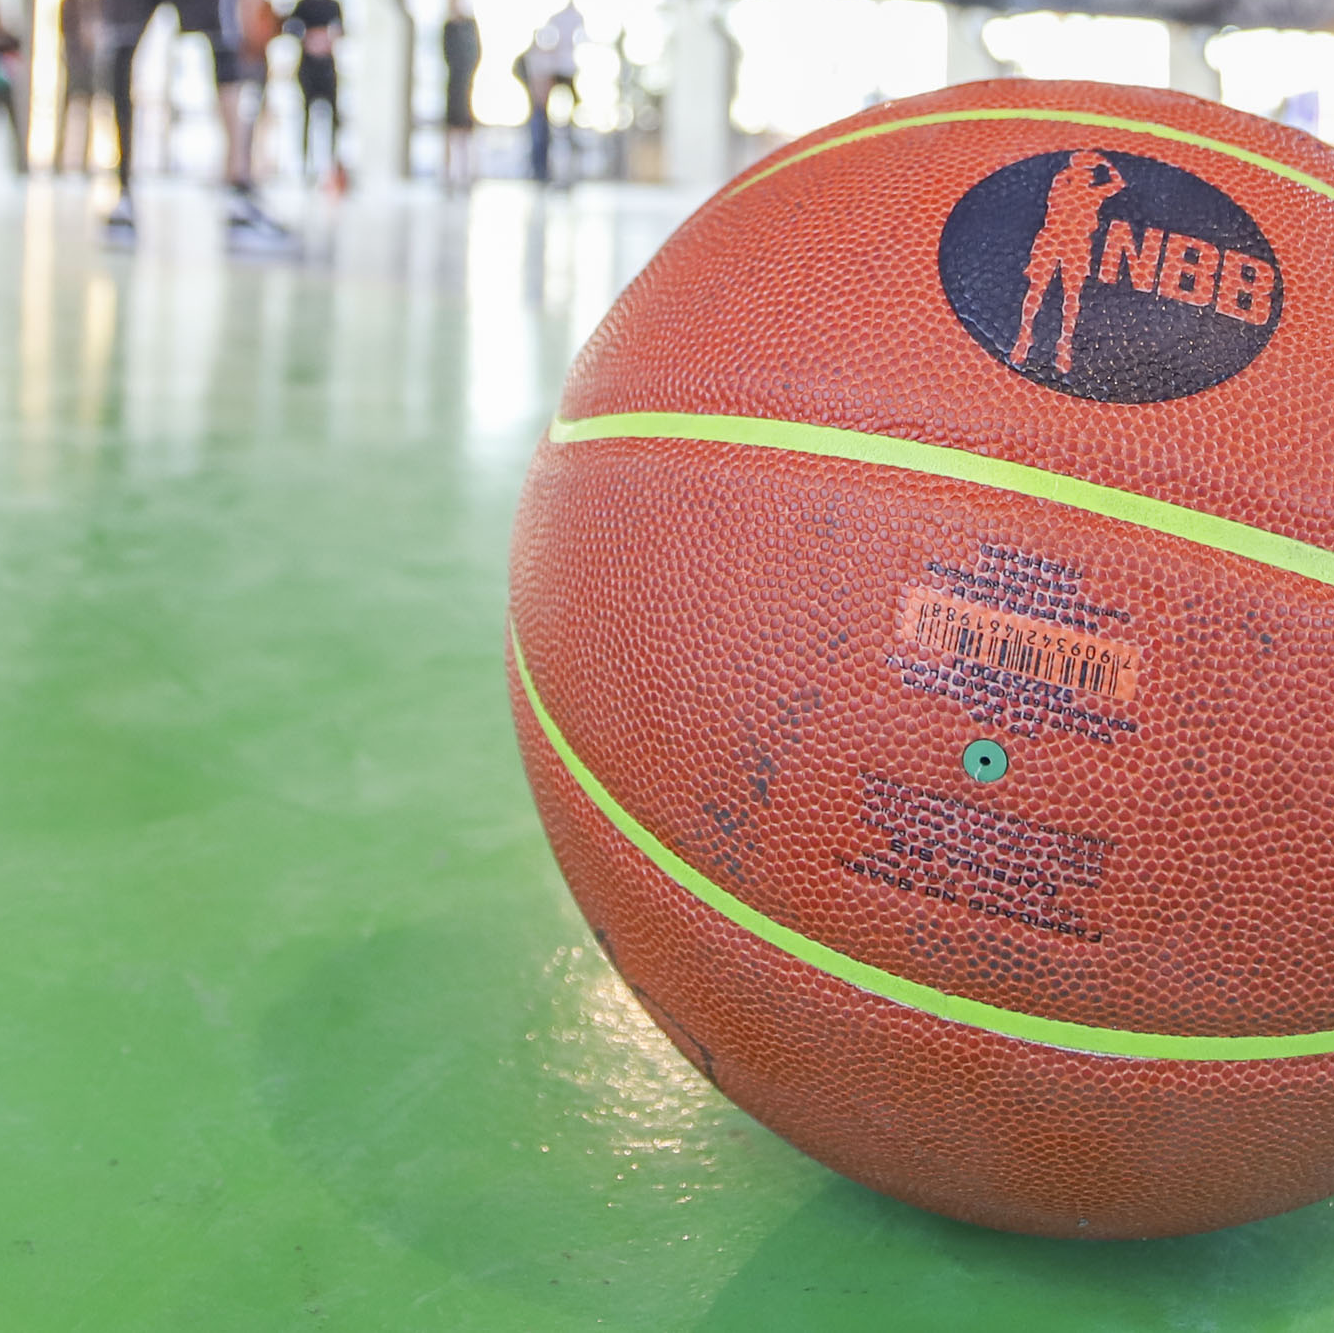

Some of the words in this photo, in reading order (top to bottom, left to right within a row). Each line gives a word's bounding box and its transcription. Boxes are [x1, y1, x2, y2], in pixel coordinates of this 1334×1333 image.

[1098, 219, 1275, 326] NBB
[949, 584, 1099, 632] www.penalty.com.br
[902, 676, 1003, 714] BRASILEIROS
[951, 675, 1020, 701] CROSSOVER
[1011, 709, 1043, 724] POR
[1040, 700, 1103, 724] BASQUETE
[1105, 717, 1136, 732] BOLA
[1050, 719, 1112, 744] CRIADO
[888, 838, 933, 862] SIS
[830, 853, 913, 891] BRASIL
[968, 899, 1102, 943] FABRICADO
